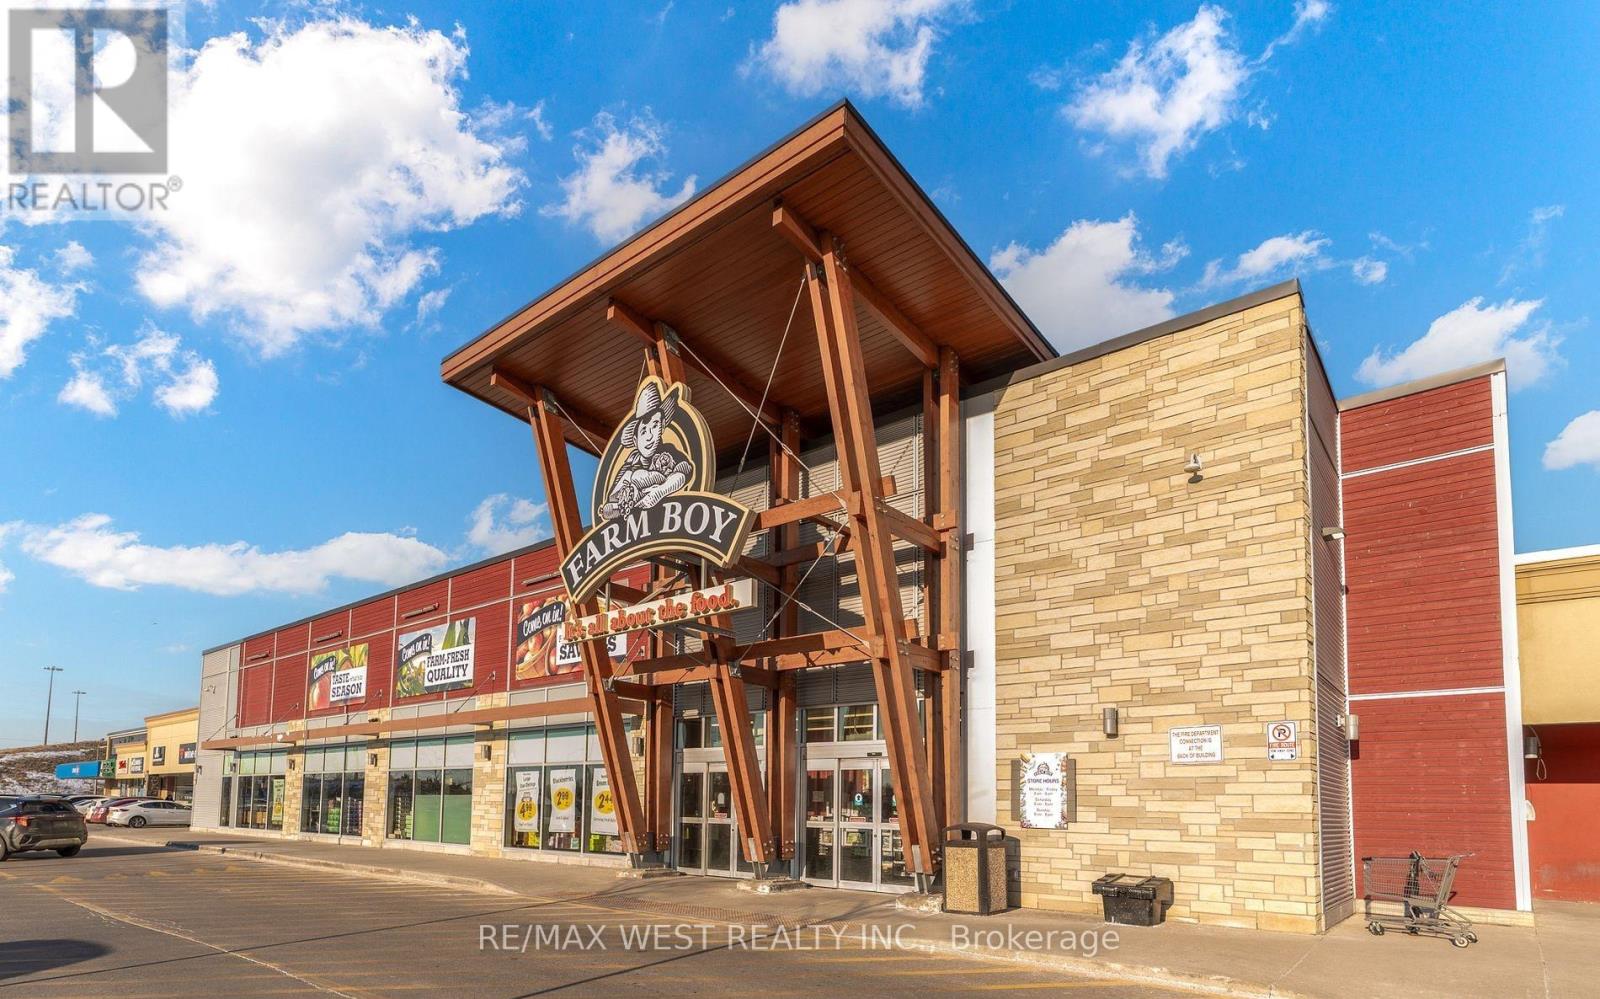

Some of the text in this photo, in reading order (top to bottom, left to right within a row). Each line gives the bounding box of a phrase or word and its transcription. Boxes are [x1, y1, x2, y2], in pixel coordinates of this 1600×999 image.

[566, 501, 737, 589] FARM BOY
[542, 611, 552, 625] on
[552, 605, 564, 622] in!
[588, 613, 609, 636] all
[610, 607, 656, 631] about
[657, 599, 687, 622] the
[690, 584, 739, 615] food.
[426, 648, 470, 668] FARM-FRESH
[332, 672, 350, 685] TASTE
[427, 664, 469, 682] QUALITY
[331, 682, 362, 698] SEASON
[1191, 729, 1219, 737] DEPARTMENT
